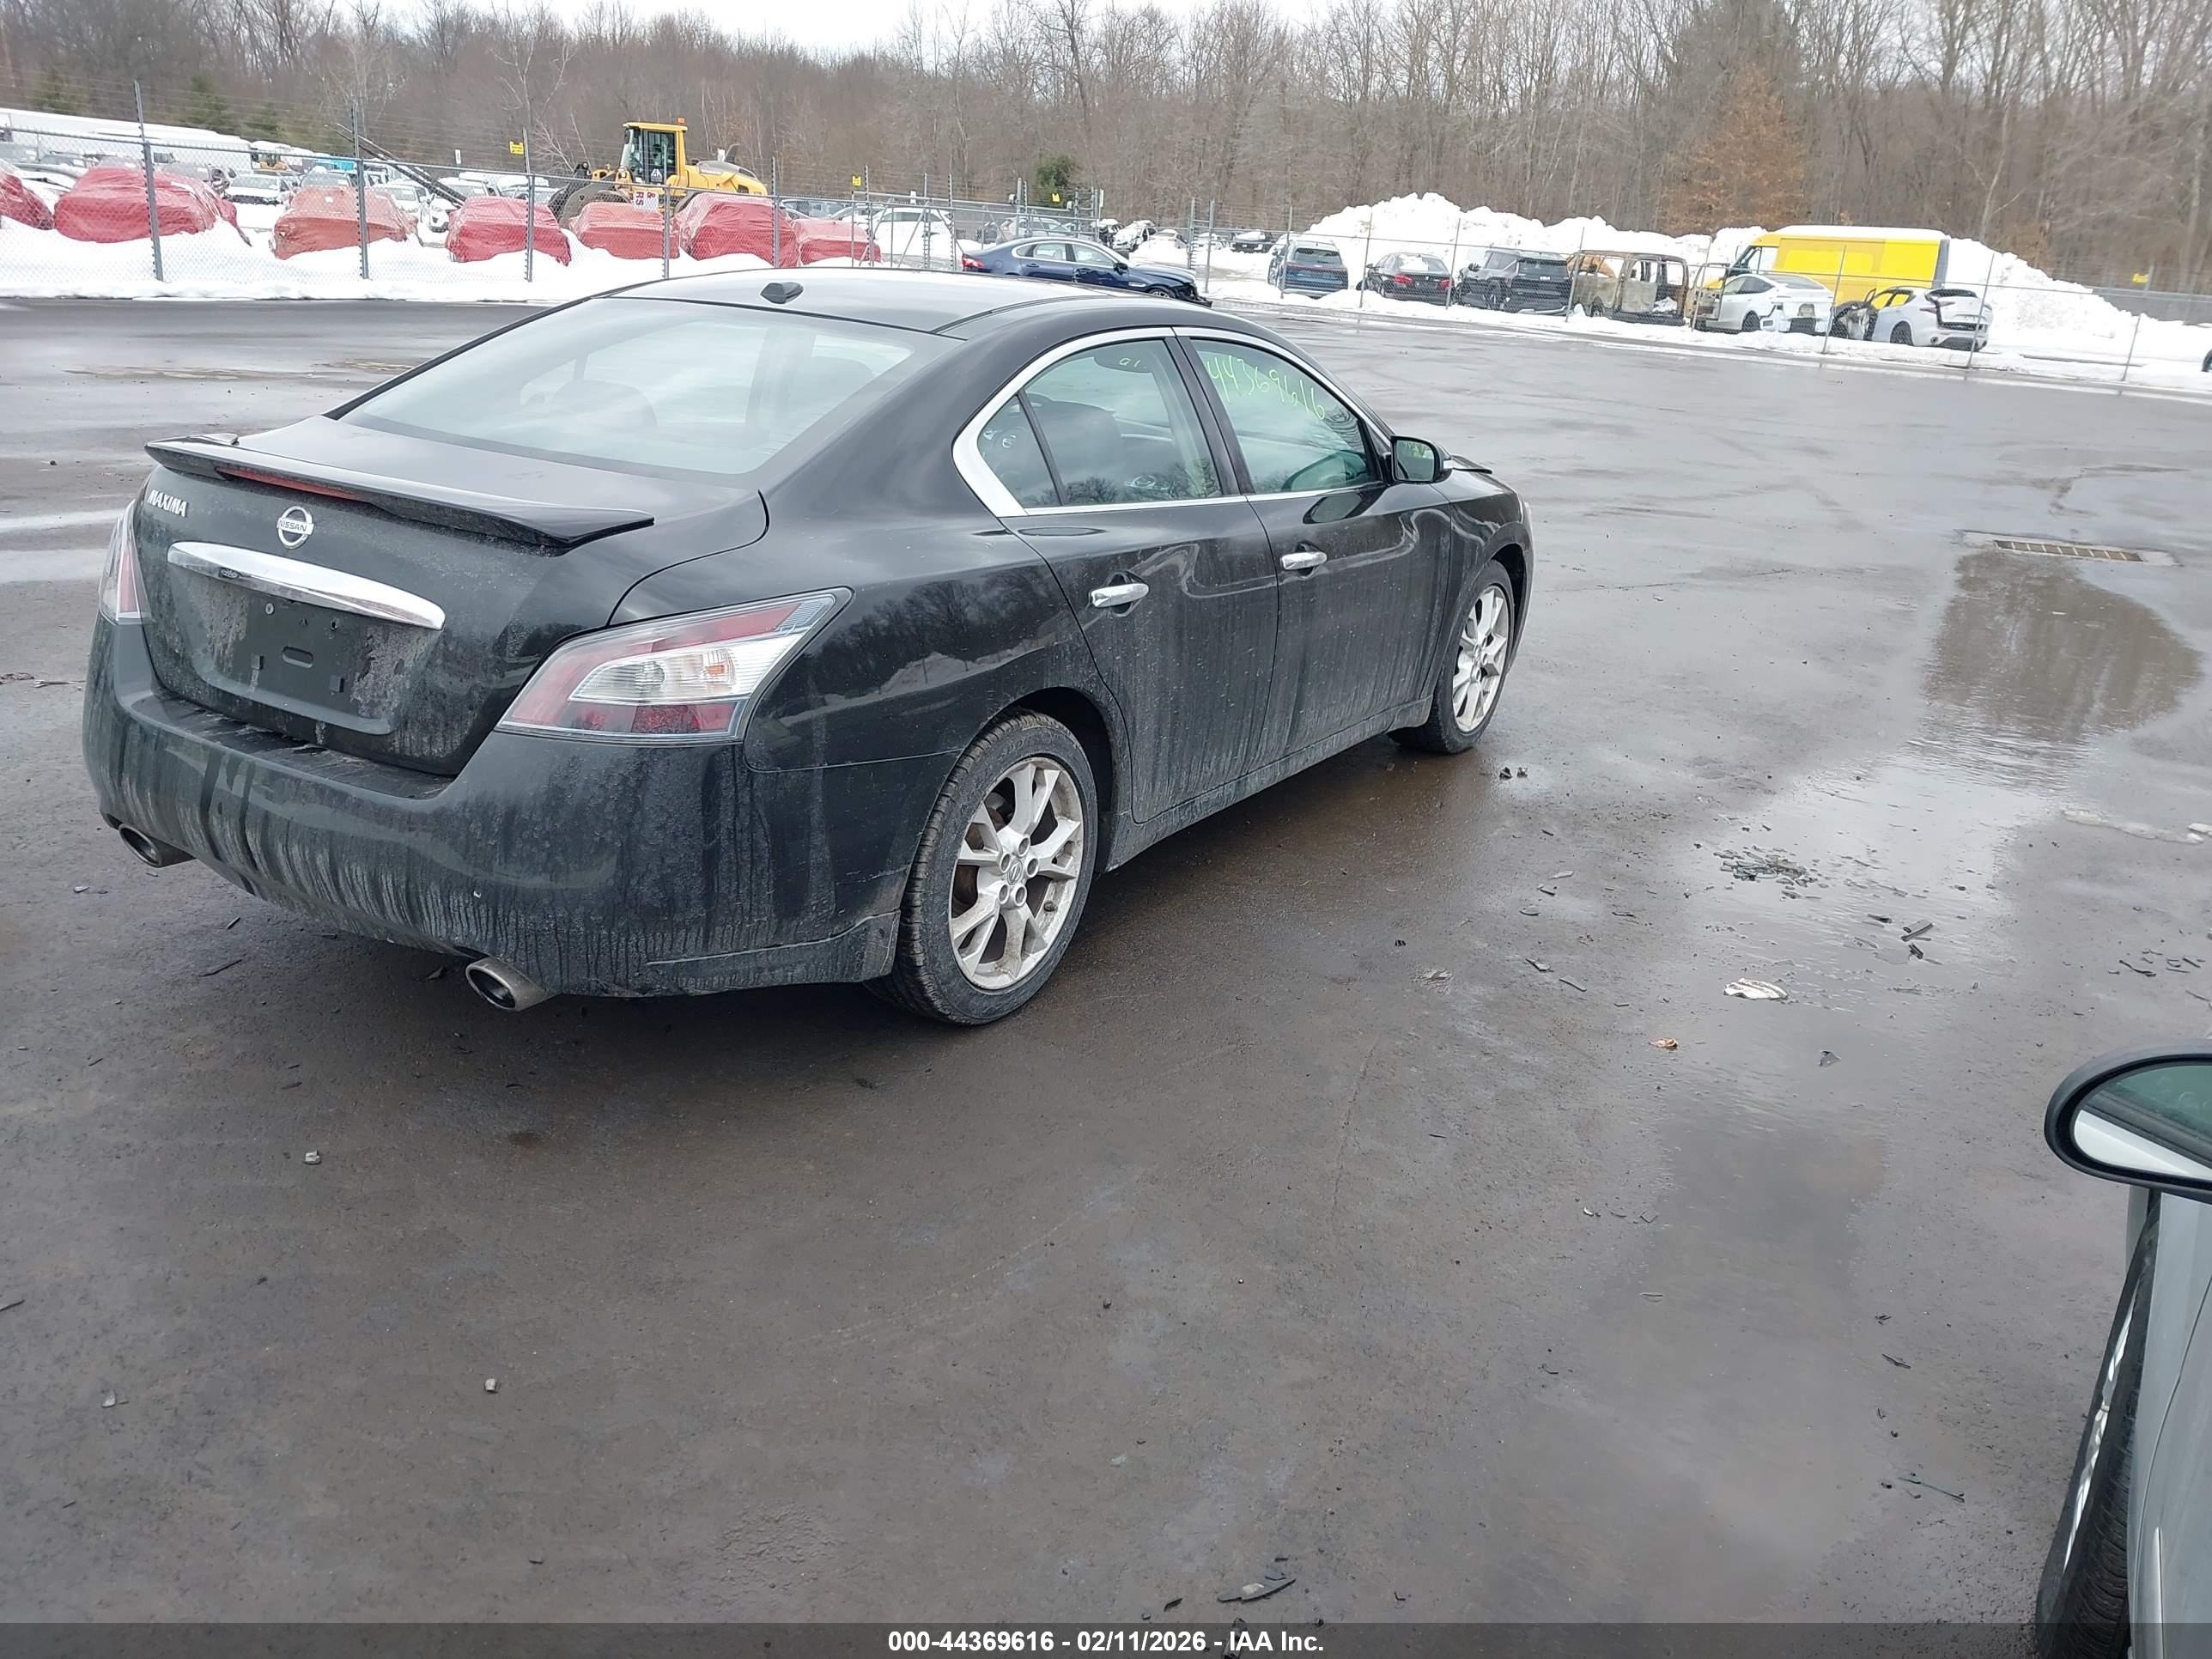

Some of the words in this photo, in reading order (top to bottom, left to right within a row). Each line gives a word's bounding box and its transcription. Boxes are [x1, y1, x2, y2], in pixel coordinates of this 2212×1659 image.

[1207, 355, 1325, 420] 44369616
[147, 489, 187, 517] MAXIMA
[279, 520, 307, 532] NISSAN
